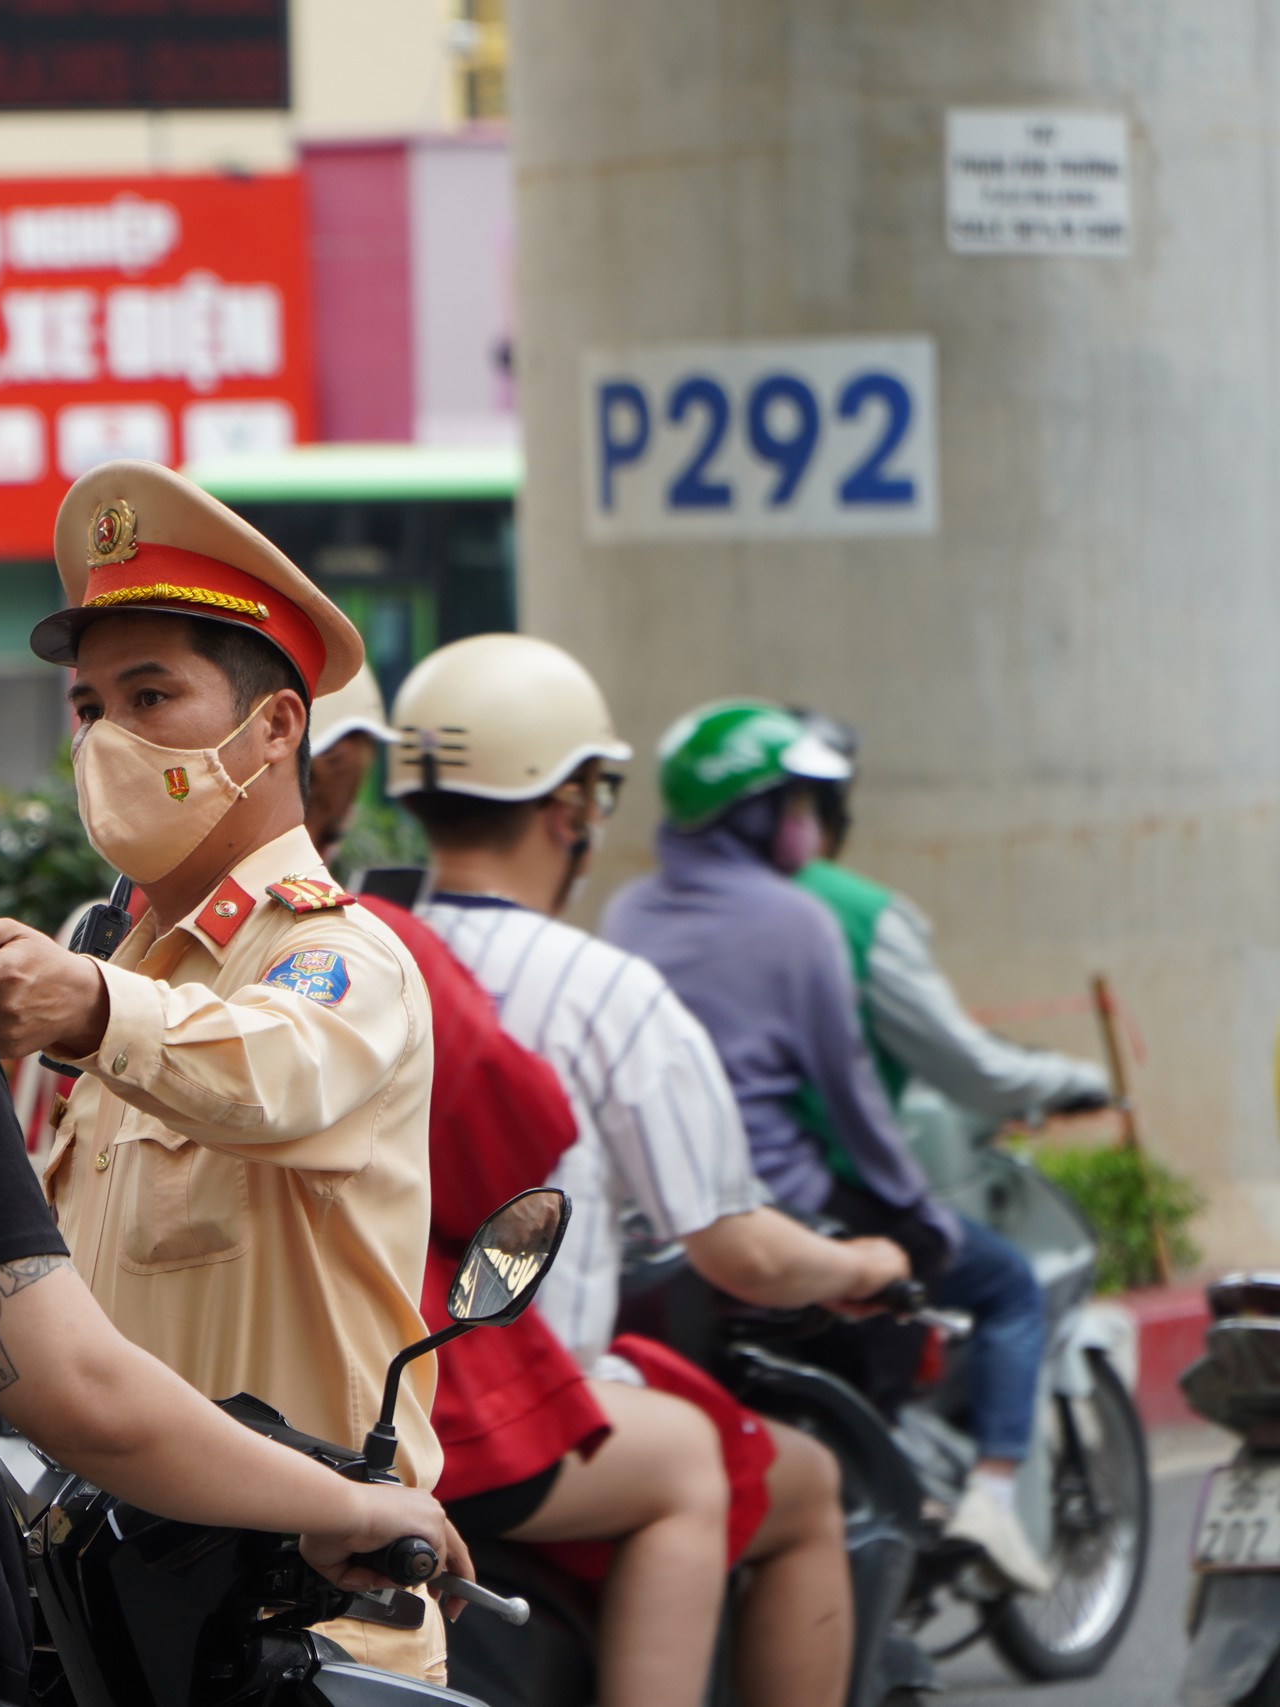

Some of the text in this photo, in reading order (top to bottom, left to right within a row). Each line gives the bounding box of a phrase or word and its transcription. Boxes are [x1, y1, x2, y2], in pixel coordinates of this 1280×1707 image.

[8, 191, 180, 277] NGHIỆP
[597, 371, 916, 516] P292
[276, 972, 334, 990] CS GT
